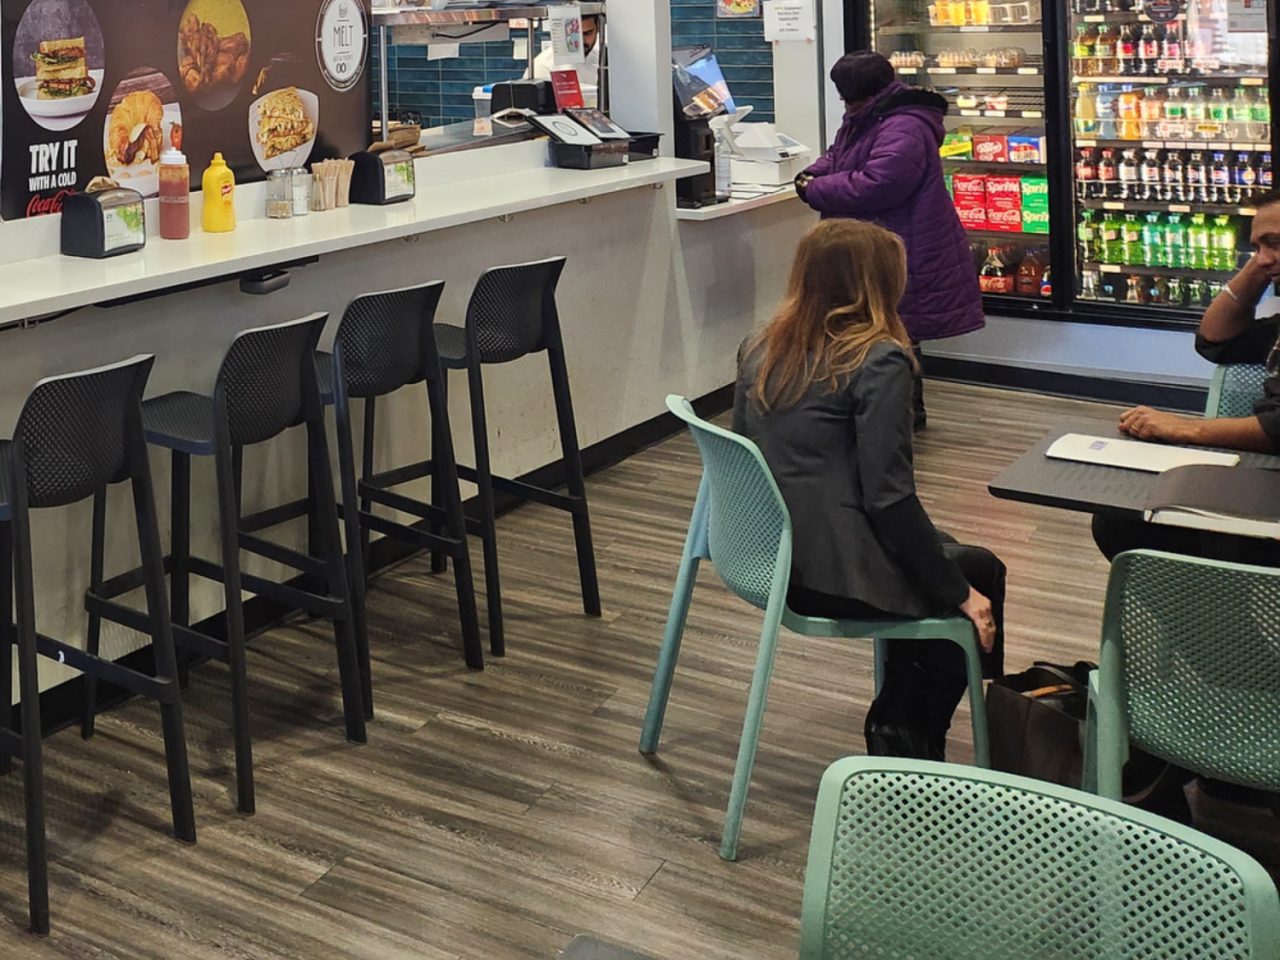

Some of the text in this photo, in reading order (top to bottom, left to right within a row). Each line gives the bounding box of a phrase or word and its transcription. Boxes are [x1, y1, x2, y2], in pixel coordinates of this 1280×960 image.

[333, 25, 354, 47] MELT
[29, 139, 78, 174] TRY IT
[29, 171, 77, 192] WITH A COLD
